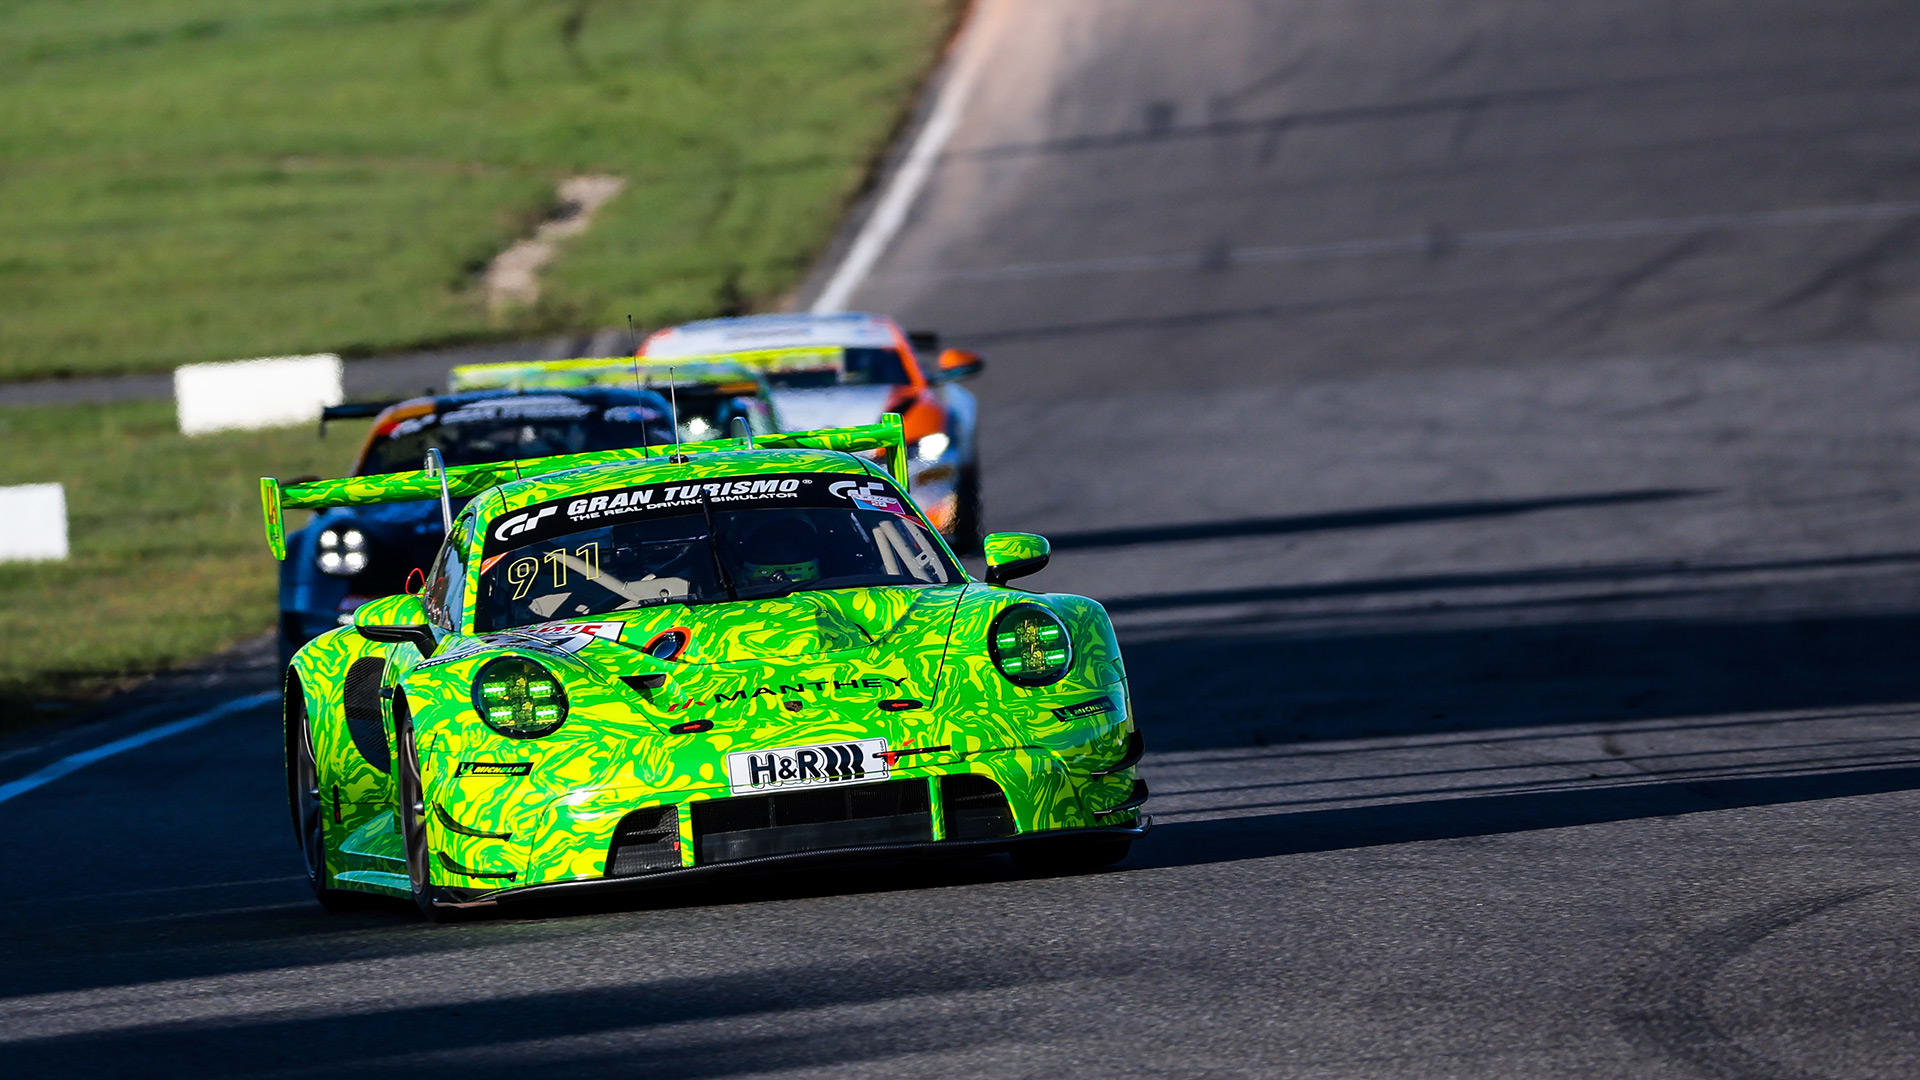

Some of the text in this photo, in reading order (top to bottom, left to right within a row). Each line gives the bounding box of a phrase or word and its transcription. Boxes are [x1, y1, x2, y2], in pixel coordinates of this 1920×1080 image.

[567, 489, 654, 517] GRAN
[569, 512, 601, 522] THE
[604, 506, 643, 517] REAL
[711, 492, 798, 503] SIMULATOR
[507, 541, 599, 601] 911
[714, 677, 908, 703] MANTHEY
[473, 766, 527, 774] MICHELIN
[749, 749, 825, 787] H&R
